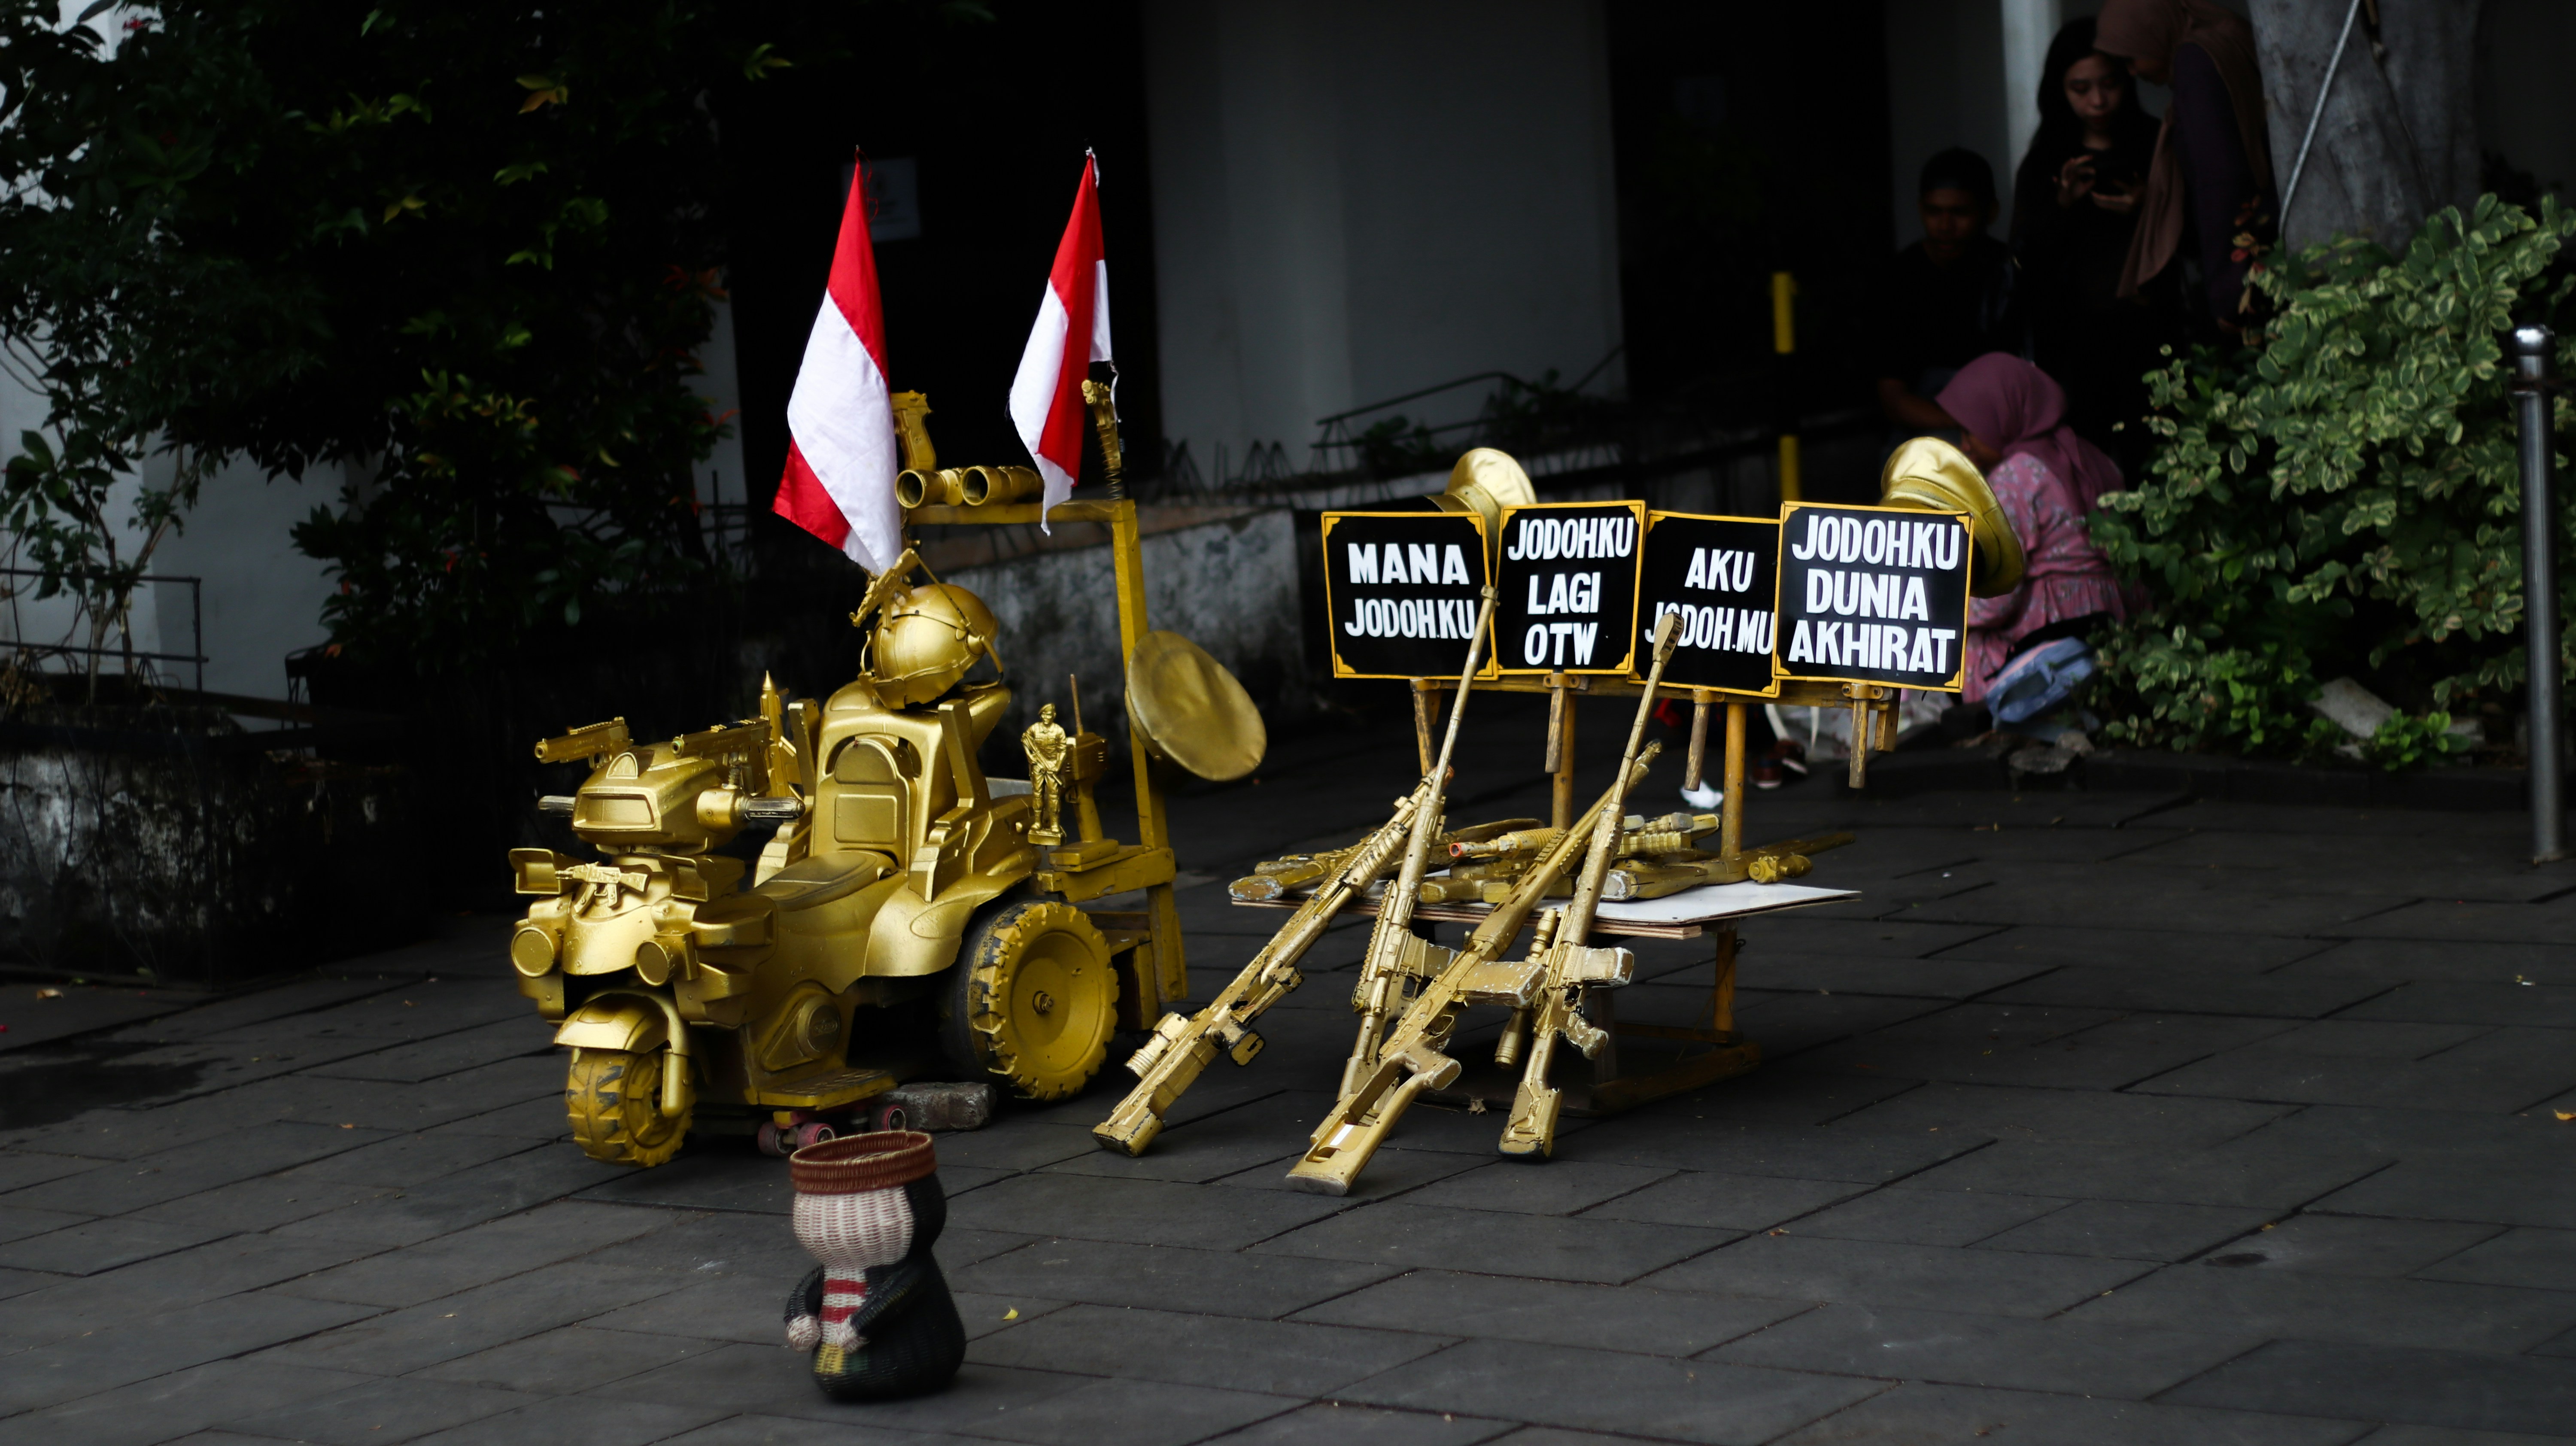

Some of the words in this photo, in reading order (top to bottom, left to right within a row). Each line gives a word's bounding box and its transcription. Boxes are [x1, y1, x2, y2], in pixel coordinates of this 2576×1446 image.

[1348, 544, 1469, 584] MANA
[1685, 548, 1754, 592] AKU
[1528, 572, 1600, 614] LAGI
[1807, 568, 1928, 621] DUNIA
[1525, 623, 1598, 665] OTW
[1644, 602, 1775, 655] JDOH.MU
[1788, 620, 1956, 673] AKHIRAT
